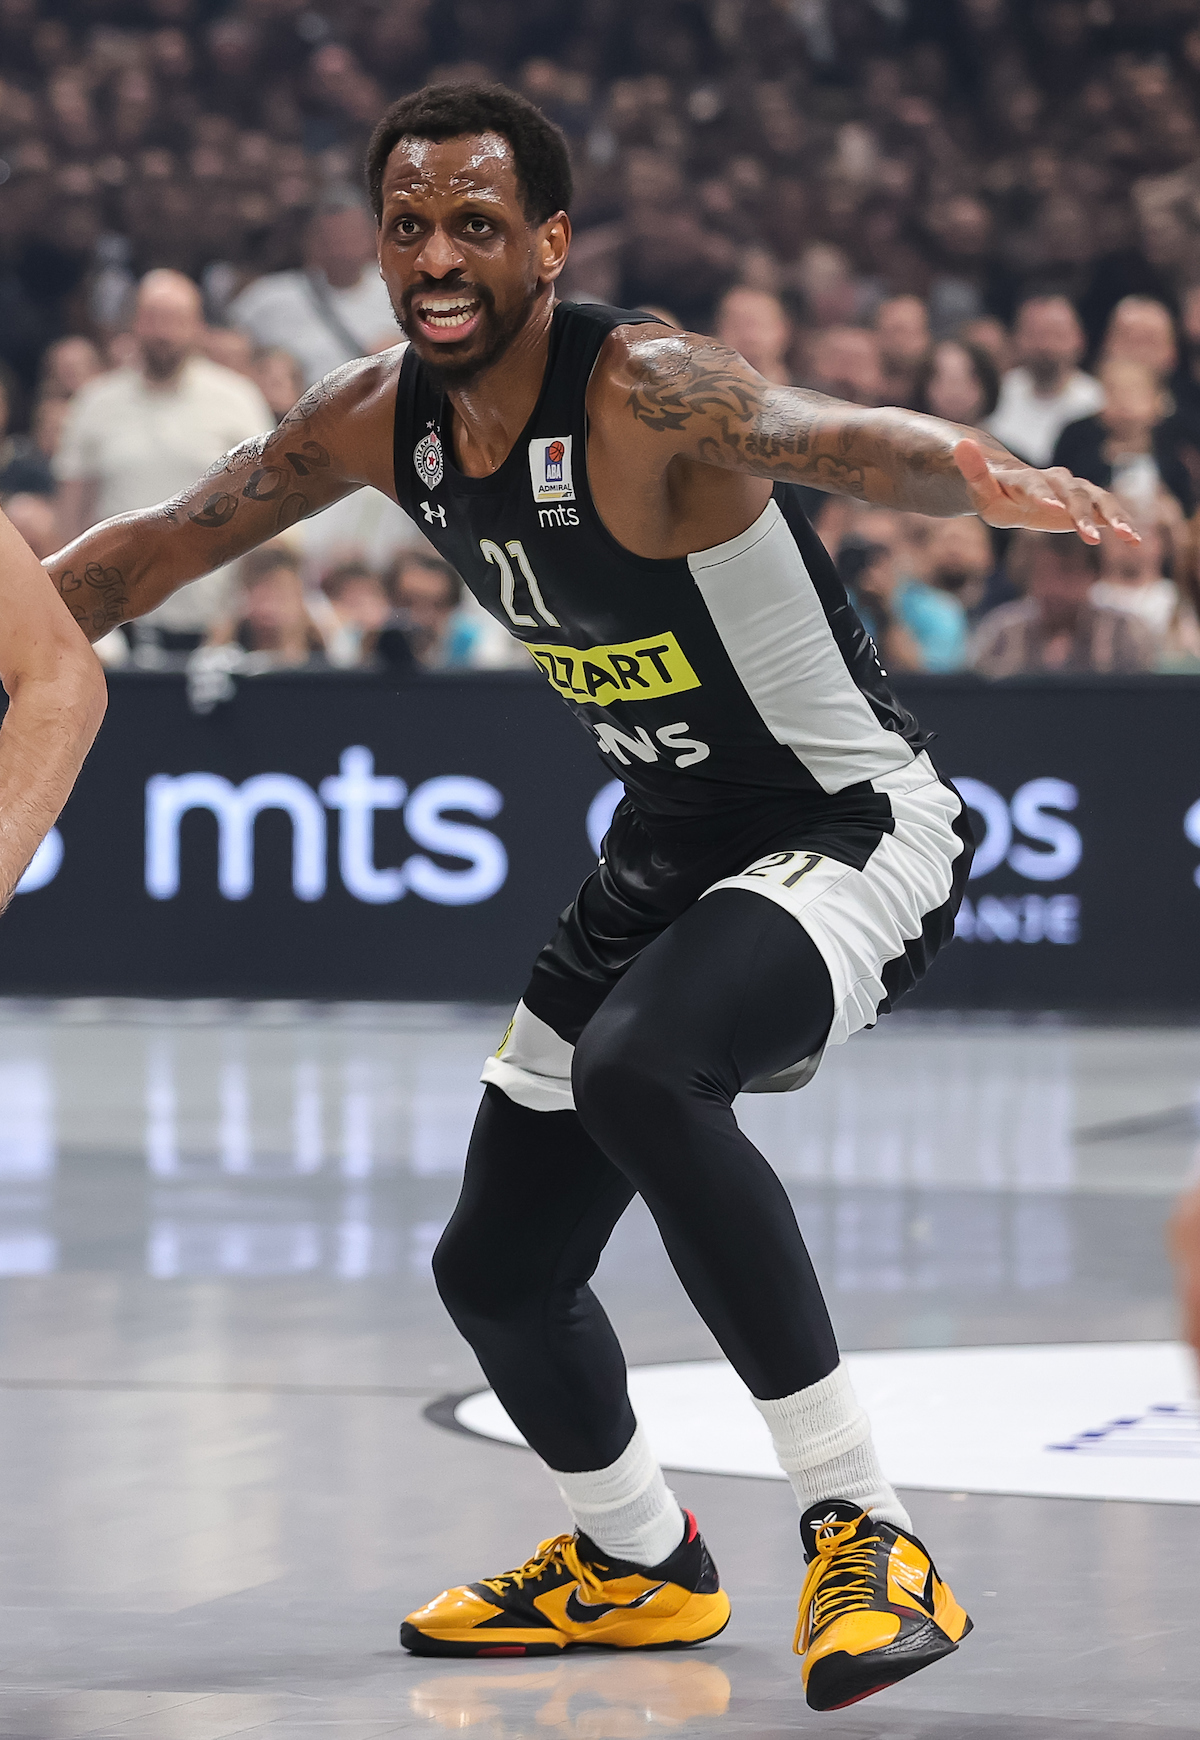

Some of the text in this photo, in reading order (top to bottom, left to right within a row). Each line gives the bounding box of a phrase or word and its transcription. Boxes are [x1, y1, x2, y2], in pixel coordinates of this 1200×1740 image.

[538, 483, 573, 493] ADMIRAL
[546, 463, 562, 480] ABA
[537, 504, 580, 528] mts
[479, 538, 562, 628] 21
[531, 644, 670, 698] ZZART
[592, 721, 711, 769] NS
[143, 744, 509, 906] mts
[741, 851, 824, 889] 21
